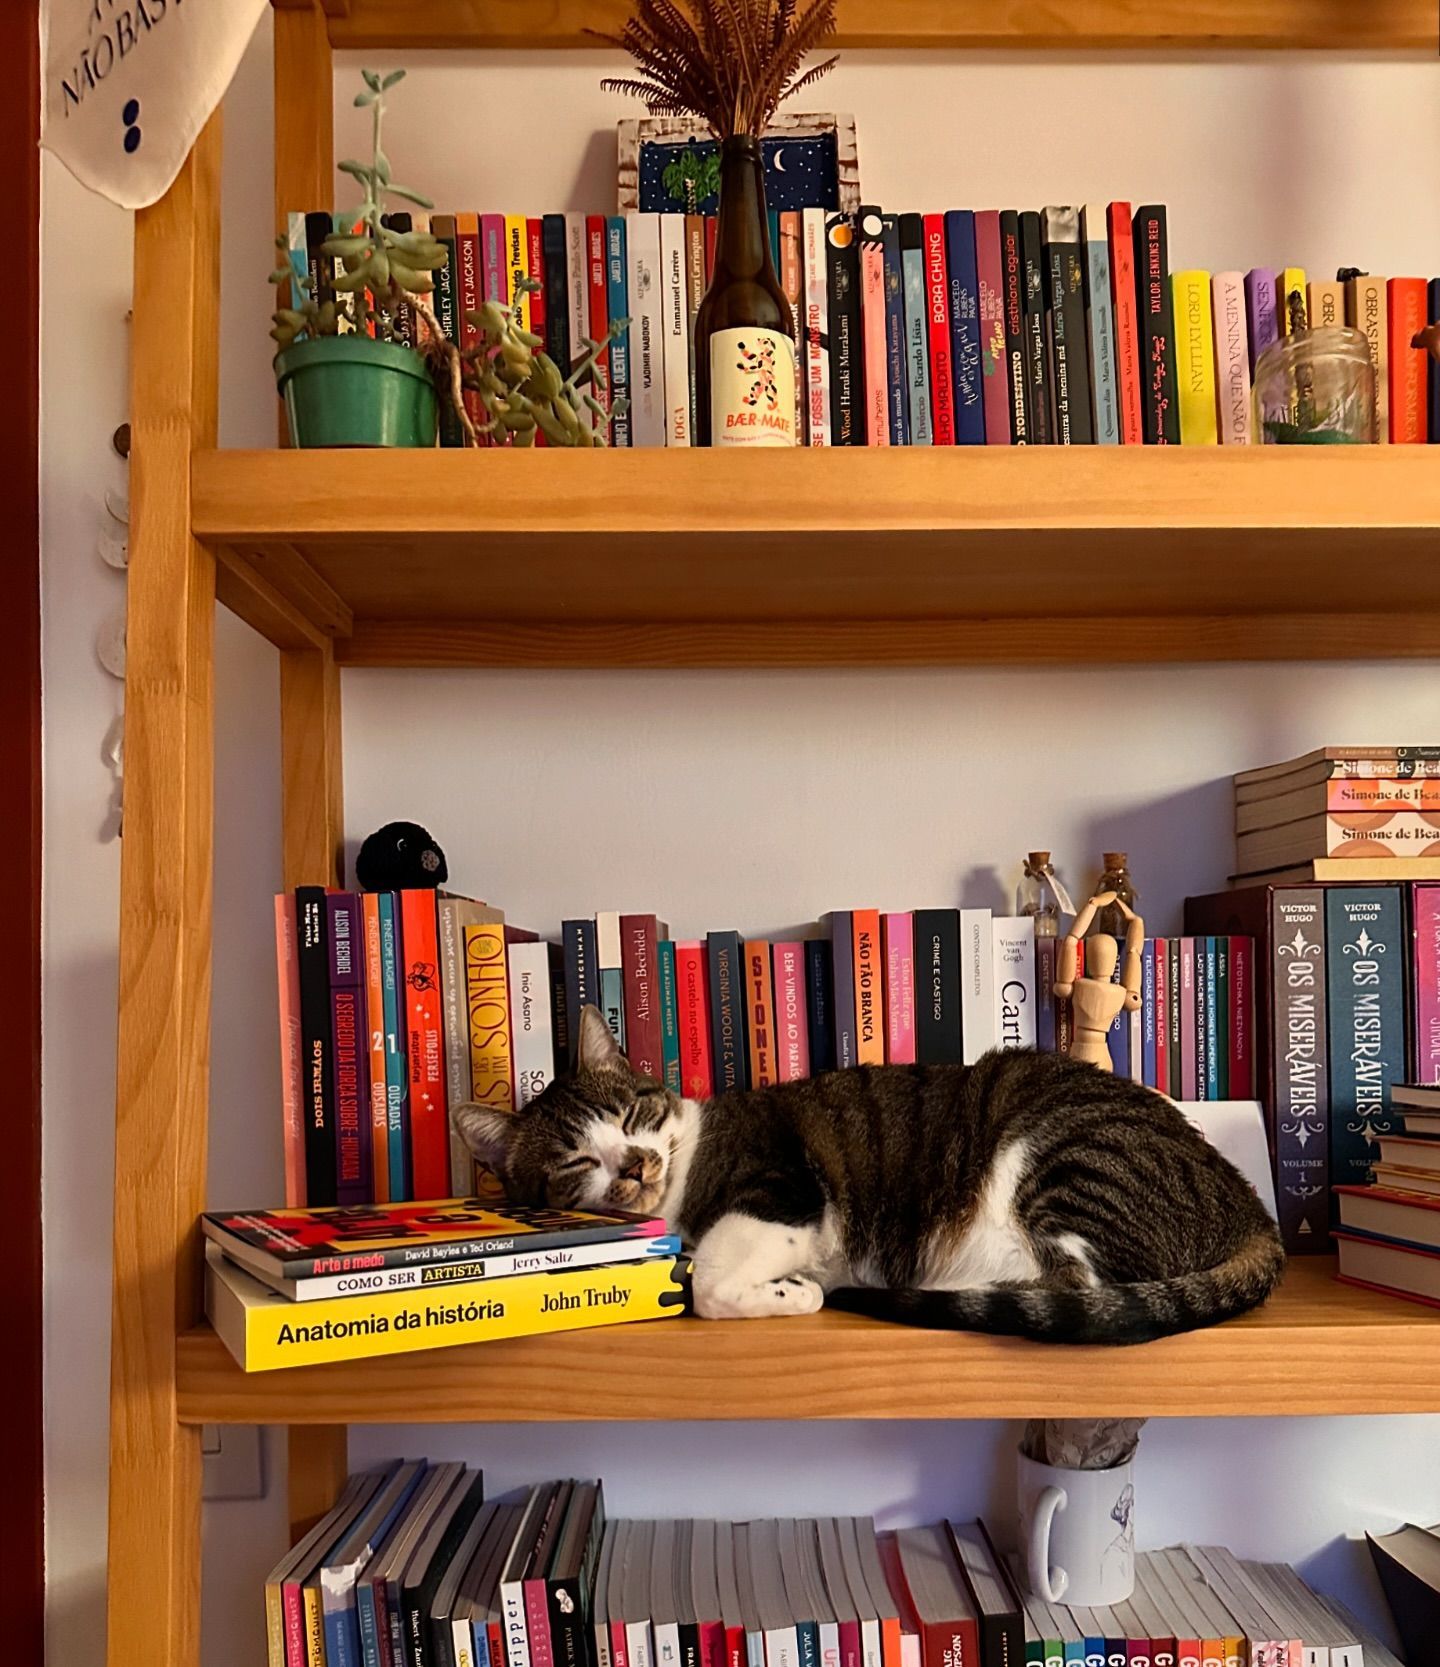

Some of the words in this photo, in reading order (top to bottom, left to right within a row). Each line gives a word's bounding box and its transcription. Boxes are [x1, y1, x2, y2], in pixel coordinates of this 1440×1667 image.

[60, 34, 114, 119] NÃO
[510, 227, 521, 268] Trevisan
[1148, 219, 1160, 240] REID
[463, 239, 475, 289] JACKSON
[670, 249, 681, 285] Carrère
[690, 231, 702, 279] Carrington
[930, 233, 943, 283] CHUNG
[1004, 234, 1018, 273] aguiar
[1051, 254, 1063, 278] Llosa
[1149, 243, 1160, 279] JENKINS
[691, 278, 701, 314] Leonora
[835, 260, 843, 300] ALFAGUARA
[1026, 259, 1035, 300] ALFAGUARA
[1053, 280, 1067, 310] Vargas
[1150, 282, 1161, 313] TAYLOR
[1224, 282, 1238, 295] A
[671, 286, 682, 336] Emmanuel
[932, 284, 945, 324] BORA
[952, 279, 962, 319] MARCELO
[960, 288, 969, 318] RUBENS
[968, 296, 976, 318] PAIVA
[979, 280, 988, 321] MARCELO
[1007, 276, 1020, 336] cristhiano
[1188, 283, 1204, 326] LORD
[1365, 287, 1379, 338] OBRAS
[442, 297, 453, 338] SHIRLEY
[641, 315, 651, 352] NABOKOV
[808, 304, 821, 360] MONSTRO
[890, 313, 901, 354] Katayama
[912, 318, 923, 346] Lísias
[1031, 313, 1041, 334] Llosa
[1053, 311, 1066, 340] Mario
[1226, 297, 1243, 361] MENINA
[837, 314, 850, 367] Murakami
[1033, 335, 1044, 360] Vargas
[1056, 345, 1067, 361] má
[611, 346, 625, 385] QUENTE
[642, 352, 652, 389] VLADIMIR
[810, 365, 822, 384] UM
[913, 348, 925, 388] Ricardo
[1034, 360, 1044, 385] Mario
[1189, 327, 1205, 393] LYLLIAN
[839, 369, 851, 406] Haruki
[935, 351, 950, 411] MALDITO
[1012, 351, 1027, 436] NORDESTINO
[1057, 362, 1068, 398] menina
[1229, 363, 1244, 398] QUE
[811, 389, 824, 426] FOSSE
[872, 389, 885, 437] mulheres
[893, 388, 903, 417] mundo
[915, 396, 928, 440] Divórcio
[1058, 399, 1069, 412] da
[1232, 400, 1248, 434] NÃO
[674, 406, 685, 440] IOGA
[726, 412, 791, 432] BÆR-MATE
[813, 433, 825, 447] SE
[839, 409, 851, 440] Wood
[894, 418, 903, 429] do
[1397, 761, 1412, 773] de
[1341, 789, 1393, 800] Simone
[1395, 788, 1411, 800] de
[1341, 828, 1394, 839] Simone
[1395, 828, 1412, 839] de
[333, 909, 350, 938] ALISON
[1279, 904, 1316, 914] VICTOR
[1284, 913, 1313, 923] HUGO
[1343, 902, 1381, 912] VICTOR
[1348, 912, 1377, 921] HUGO
[442, 906, 455, 957] sentimentos
[858, 932, 873, 960] NÃO
[973, 923, 981, 953] CONTOS
[335, 940, 352, 975] BECHDEL
[576, 928, 587, 999] SPIEGELMAN
[634, 928, 648, 978] Bechdel
[932, 935, 941, 966] CRIME
[1197, 953, 1205, 974] LADY
[521, 972, 533, 993] Inio
[687, 972, 700, 1009] castelo
[718, 948, 730, 1003] VIRGINIA
[783, 952, 798, 1019] BEM-VINDOS
[860, 962, 875, 989] TÃO
[973, 954, 982, 997] COMPLETOS
[1145, 955, 1153, 1000] FELICIDADE
[1157, 962, 1165, 987] MORTE
[1288, 961, 1315, 987] OS
[1353, 960, 1380, 986] OS
[467, 933, 507, 1050] SONHO
[636, 981, 650, 1021] Alison
[933, 977, 942, 1021] CASTIGO
[1198, 976, 1206, 1012] MACBETH
[336, 1002, 356, 1047] SEGREDO
[521, 995, 533, 1031] Asano
[688, 1010, 698, 1026] no
[720, 1003, 733, 1048] WOOLF
[861, 991, 874, 1043] BRANCA
[1173, 1002, 1181, 1043] KREUTZER
[1198, 1014, 1206, 1026] DO
[1208, 1007, 1216, 1035] HOMEM
[372, 1030, 384, 1052] 2
[386, 1033, 397, 1055] 1
[409, 1030, 420, 1054] Satrapi
[689, 1026, 702, 1066] espelho
[786, 1023, 797, 1040] AO
[1060, 1013, 1068, 1052] SUBSOLO
[1198, 1027, 1206, 1062] DISTRITO
[311, 1039, 323, 1094] IRMÃOS
[338, 1049, 356, 1063] DA
[411, 1054, 422, 1084] Marjane
[424, 1029, 440, 1083] PERSÉPOLIS
[492, 1055, 509, 1073] UM
[1199, 1063, 1206, 1074] DE
[1285, 994, 1323, 1117] MISERÁVEIS
[1351, 993, 1389, 1116] MISERÁVEIS
[337, 1065, 357, 1097] FORÇA
[724, 1062, 736, 1088] VITA
[314, 1095, 325, 1128] DOIS
[372, 1081, 386, 1128] OUSADAS
[387, 1085, 401, 1131] OUSADAS
[339, 1098, 360, 1180] SOBRE-HUMANA
[1282, 1160, 1323, 1168] VOLUME
[313, 1254, 342, 1275] Arte
[342, 1258, 352, 1271] e
[353, 1252, 386, 1270] medo
[405, 1247, 431, 1262] David
[432, 1245, 461, 1261] Bayles
[470, 1242, 485, 1254] Ted
[486, 1238, 514, 1252] Orland
[336, 1274, 384, 1292] COMO
[387, 1270, 416, 1286] SER
[423, 1261, 484, 1282] ARTISTA
[511, 1254, 542, 1273] Jerry
[544, 1250, 574, 1266] Saltz
[276, 1313, 388, 1346] Anatomia
[393, 1308, 421, 1332] da
[425, 1299, 506, 1328] história
[540, 1288, 582, 1314] John
[583, 1283, 633, 1311] Truby
[411, 1610, 422, 1638] Hubert
[565, 1626, 575, 1660] PATRICK
[803, 1631, 813, 1659] JULIA
